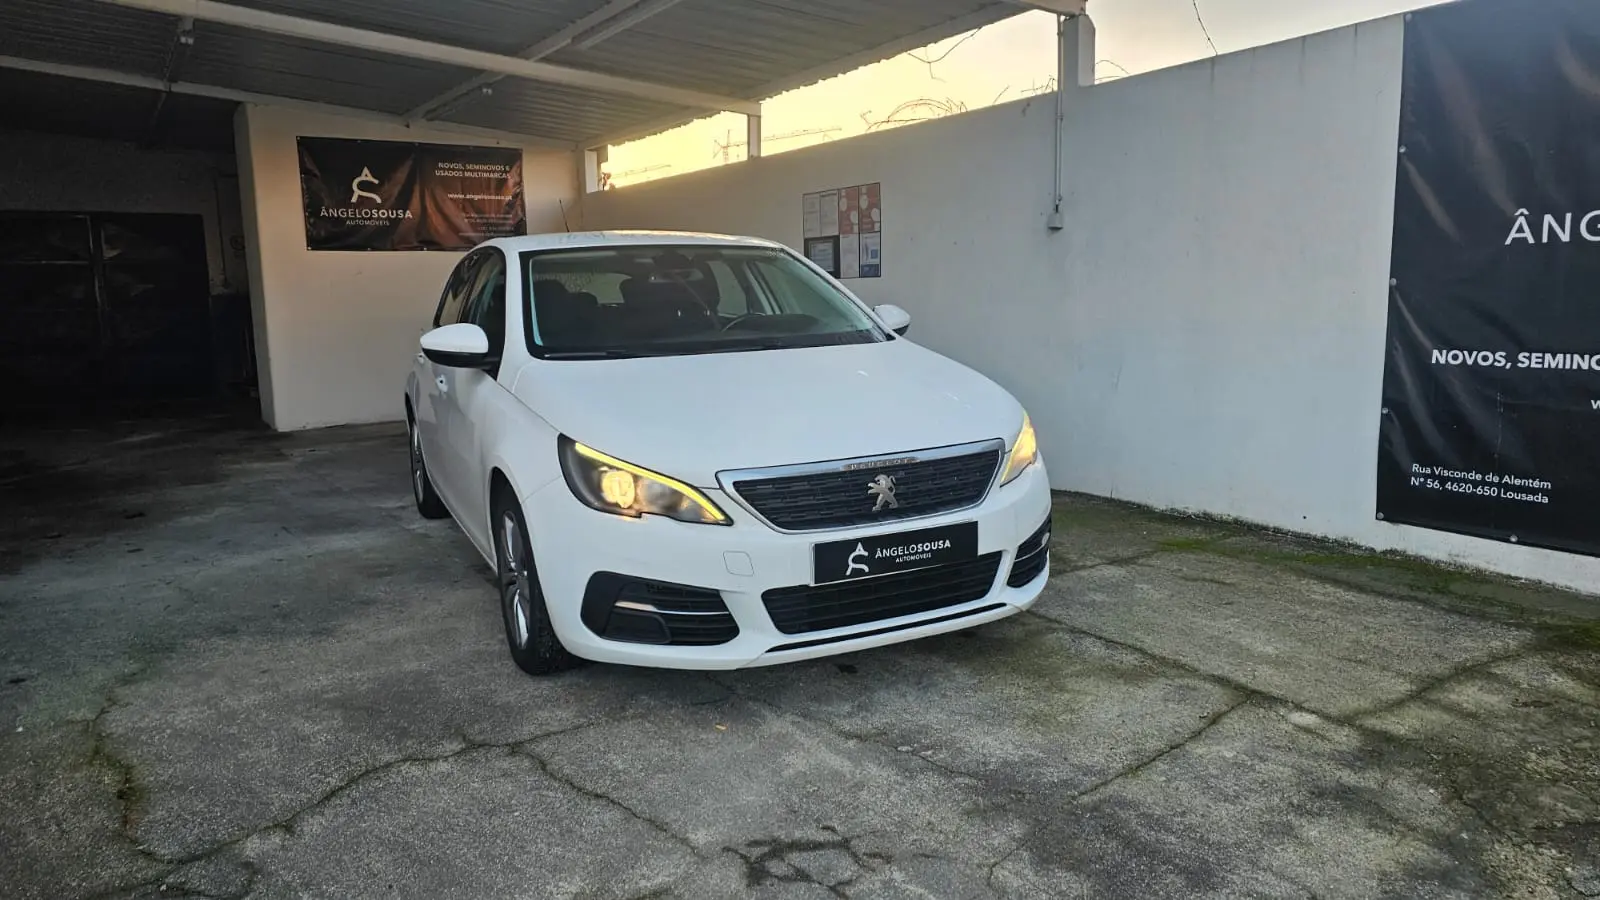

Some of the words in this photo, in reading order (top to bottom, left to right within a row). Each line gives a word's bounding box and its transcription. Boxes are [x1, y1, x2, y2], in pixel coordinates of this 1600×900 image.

[438, 162, 465, 170] NOVOS,
[319, 206, 413, 219] ÂNGELOSOUSA
[1431, 349, 1512, 370] NOVOS,
[1412, 463, 1432, 475] Rua
[1433, 466, 1482, 481] Visconde
[1485, 471, 1500, 483] de
[1502, 474, 1552, 490] Alentém
[1426, 479, 1443, 491] 56,
[1445, 481, 1499, 497] 4620-650
[1501, 488, 1550, 504] Lousada
[875, 539, 951, 559] ÂNGELOSOUSA
